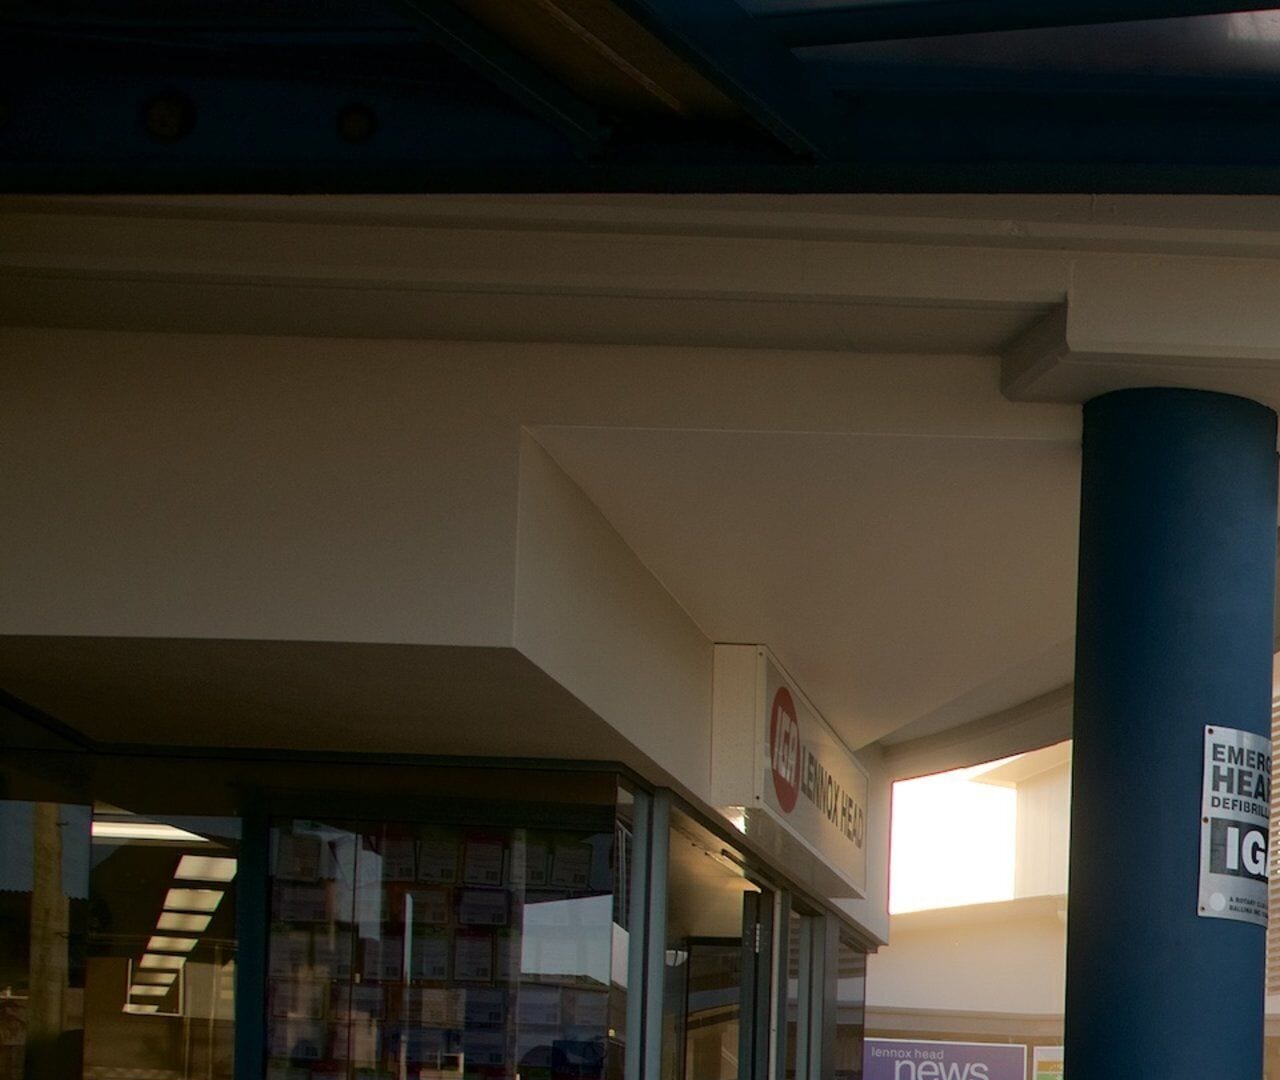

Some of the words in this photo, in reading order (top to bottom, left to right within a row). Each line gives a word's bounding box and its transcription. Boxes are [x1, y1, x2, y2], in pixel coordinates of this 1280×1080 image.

[800, 744, 841, 827] LENNOX
[839, 788, 865, 850] HEAD
[1226, 826, 1269, 880] IG
[871, 1046, 912, 1060] lennox
[914, 1048, 945, 1061] head
